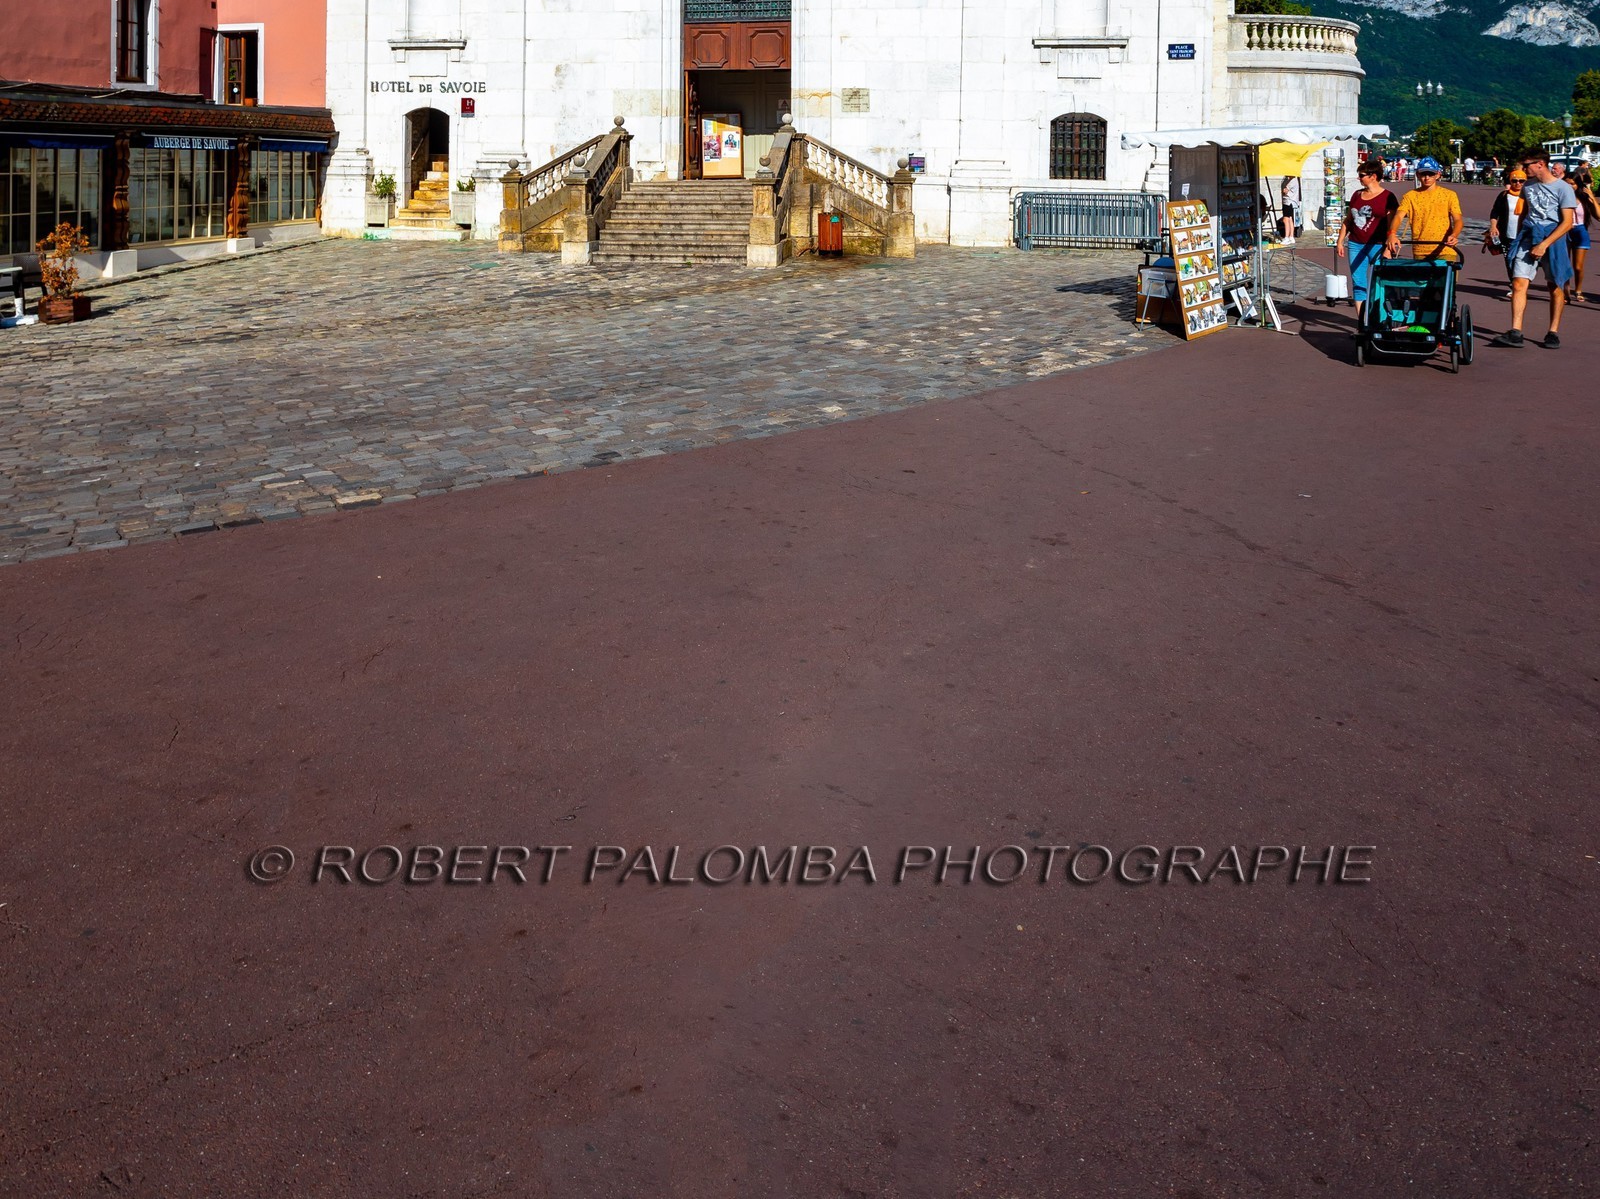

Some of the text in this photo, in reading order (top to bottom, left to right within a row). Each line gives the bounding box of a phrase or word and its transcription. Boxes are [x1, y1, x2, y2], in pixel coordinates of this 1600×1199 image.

[370, 81, 486, 93] HOTEL DE SAVOIE
[154, 137, 230, 150] AUBERGE DE SAVOIE
